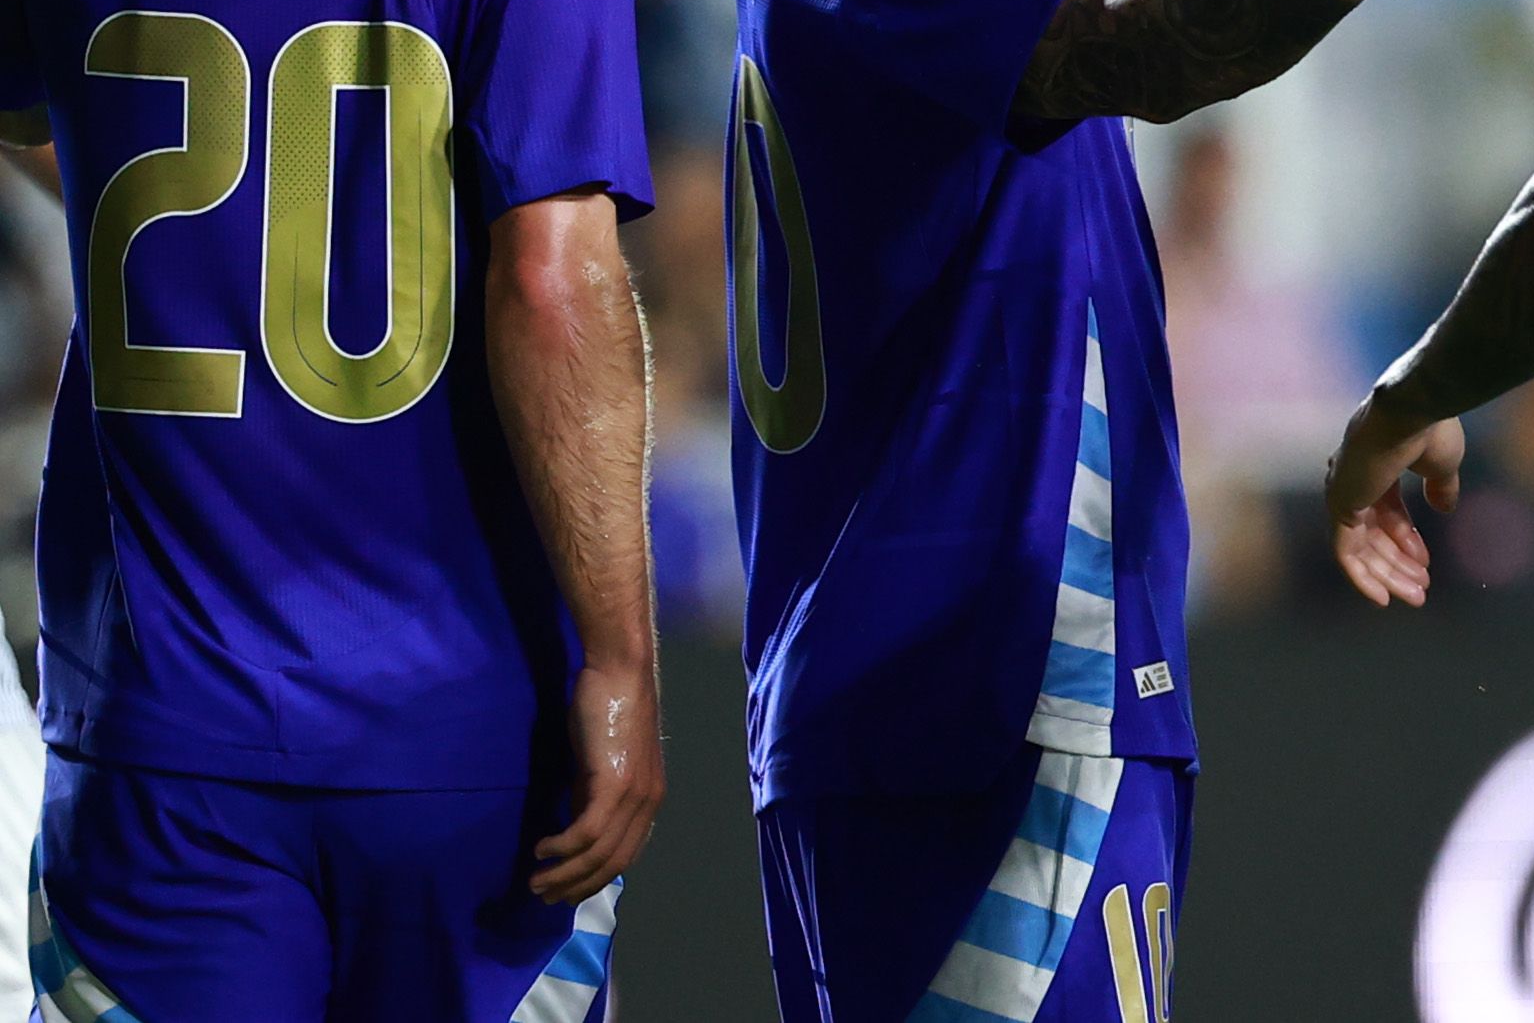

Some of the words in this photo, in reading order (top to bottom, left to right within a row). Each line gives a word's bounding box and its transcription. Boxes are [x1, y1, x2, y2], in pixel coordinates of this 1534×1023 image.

[85, 10, 455, 424] 20
[732, 53, 826, 454] 0
[1102, 881, 1174, 1023] 10
